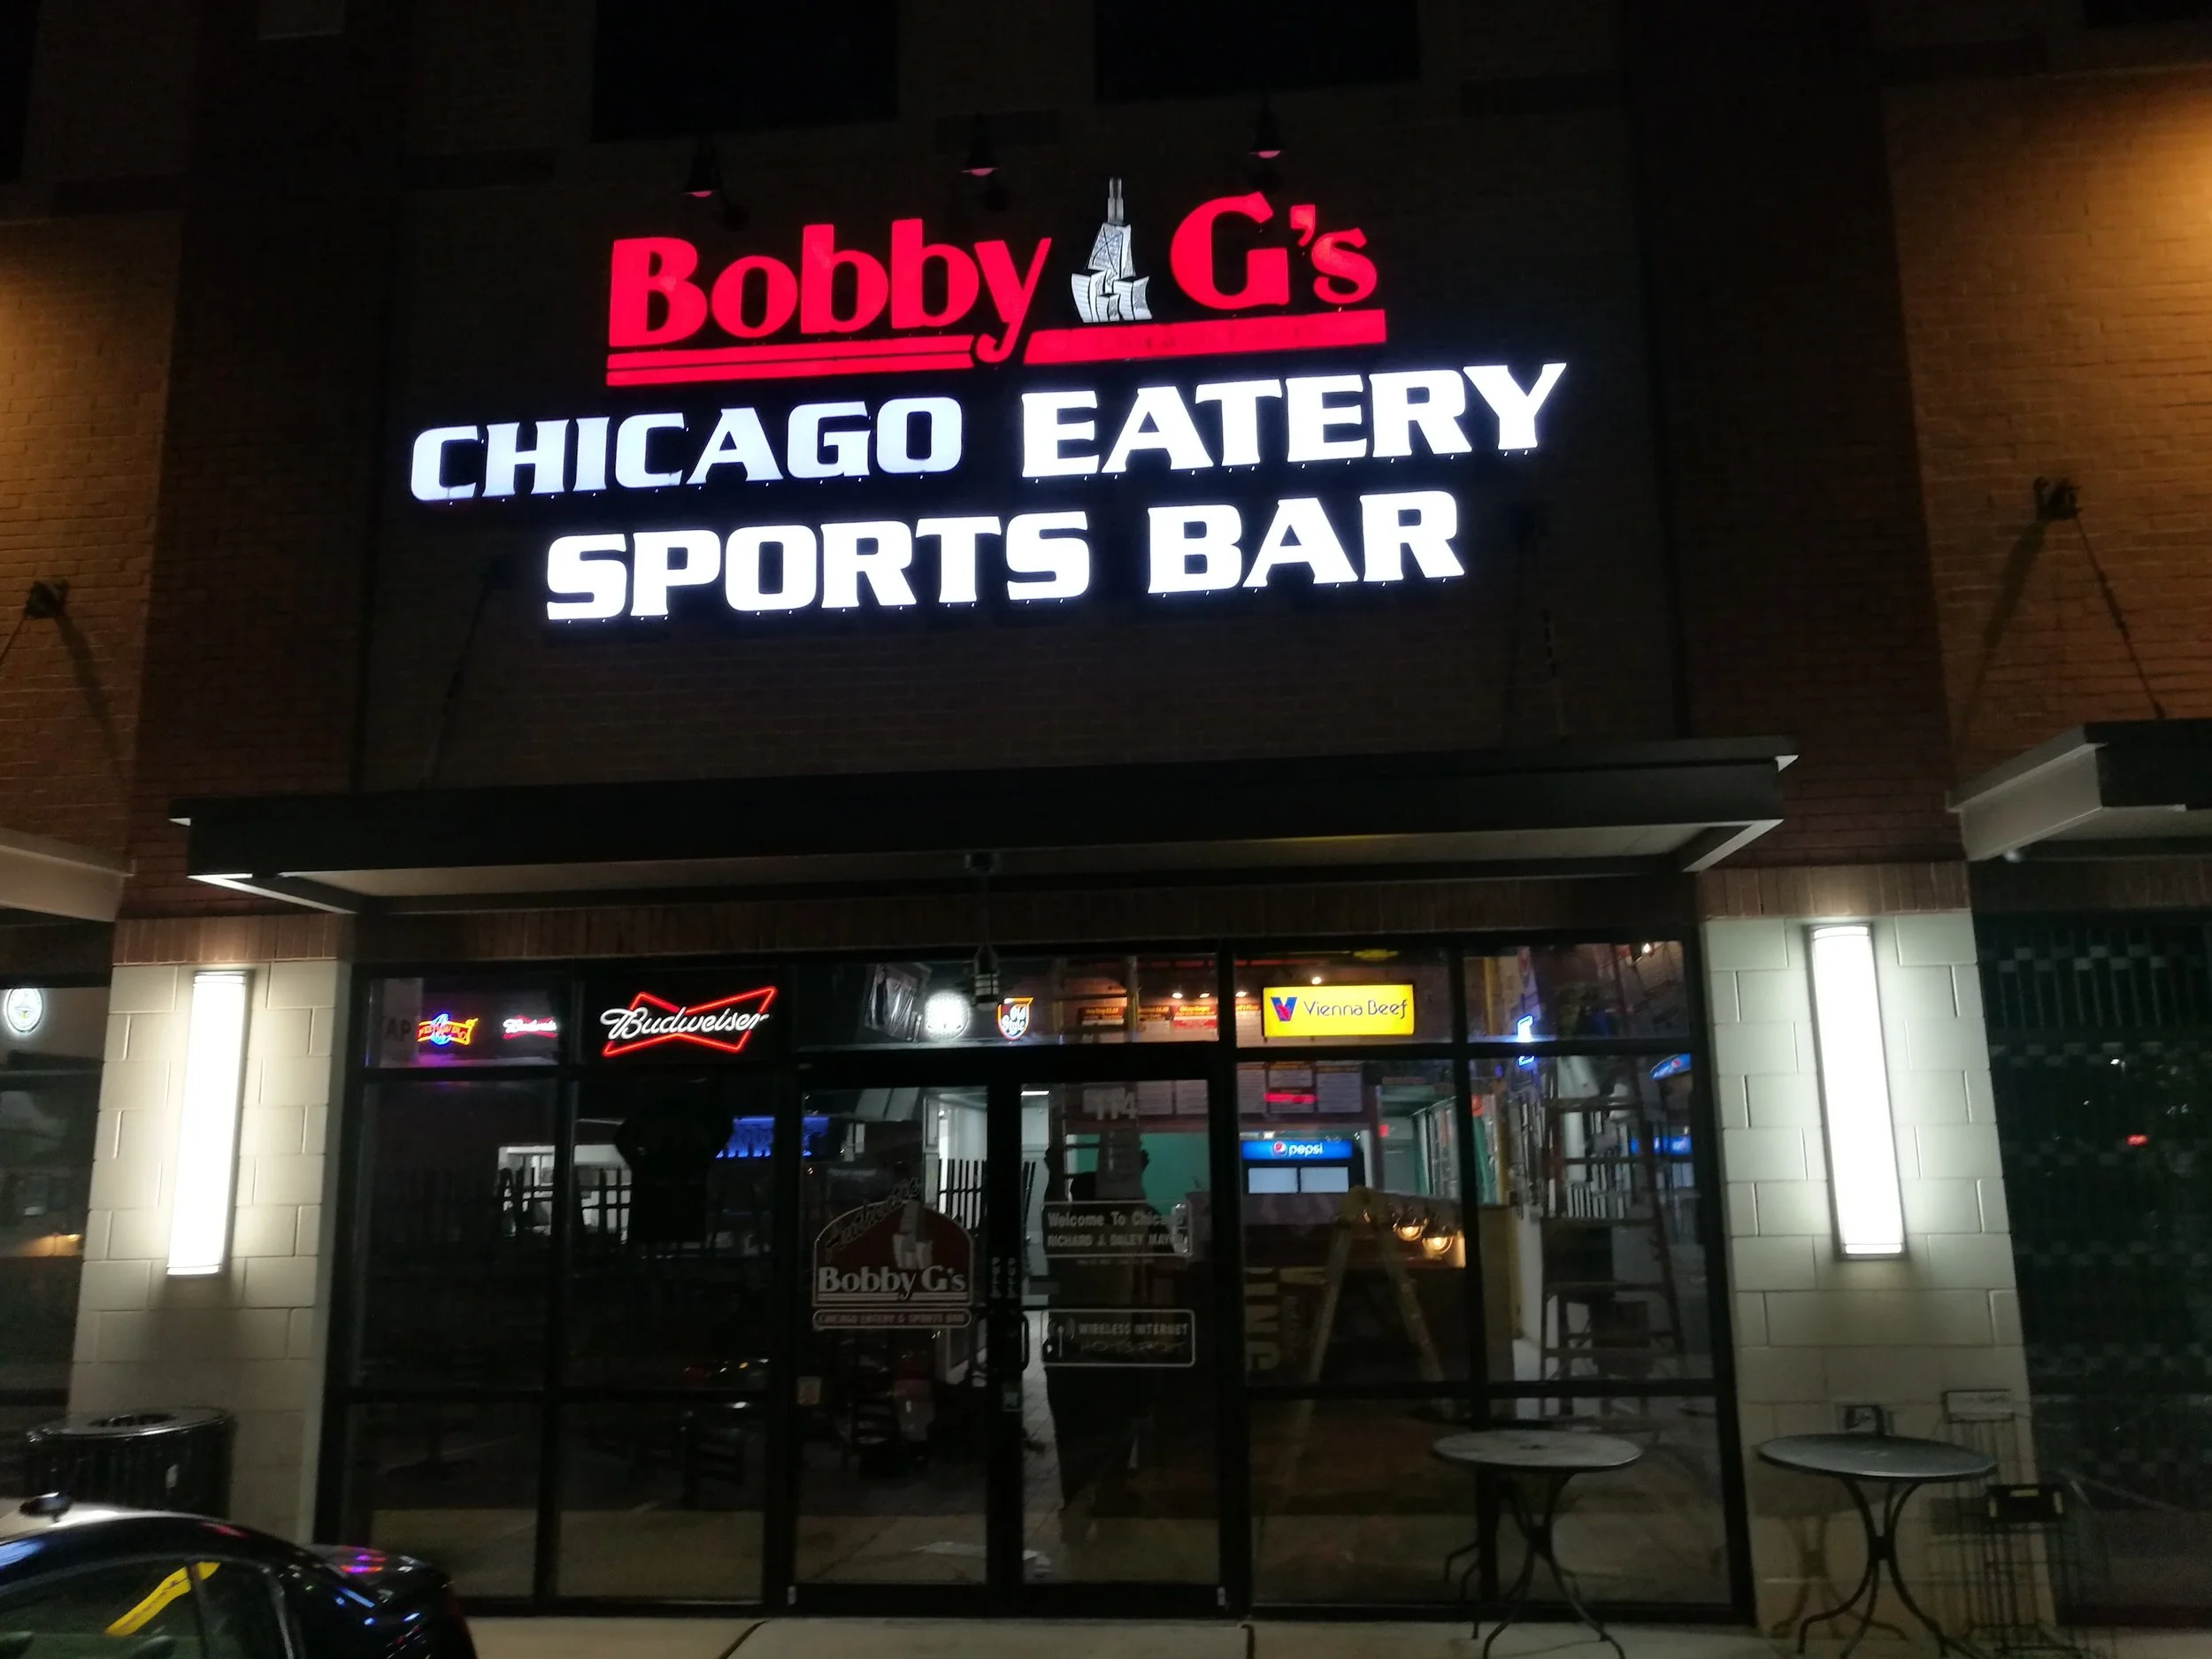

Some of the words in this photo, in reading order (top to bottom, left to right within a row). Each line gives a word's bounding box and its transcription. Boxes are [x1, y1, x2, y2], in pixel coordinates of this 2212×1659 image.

[608, 218, 1052, 365] Bobby
[1171, 191, 1378, 311] G's
[411, 396, 963, 501] CHICAGO
[1021, 363, 1567, 478] EATERY
[546, 511, 1090, 620] SPORTS
[1147, 490, 1465, 594] BAR
[601, 1006, 772, 1040] Budweiser
[1304, 1000, 1363, 1017] Vienna
[1368, 998, 1408, 1019] Beef
[1288, 1141, 1324, 1158] pepsi
[1048, 1210, 1105, 1228] Welcome
[1110, 1210, 1126, 1226] To
[818, 1266, 918, 1301] Bobby
[921, 1265, 966, 1292] G's
